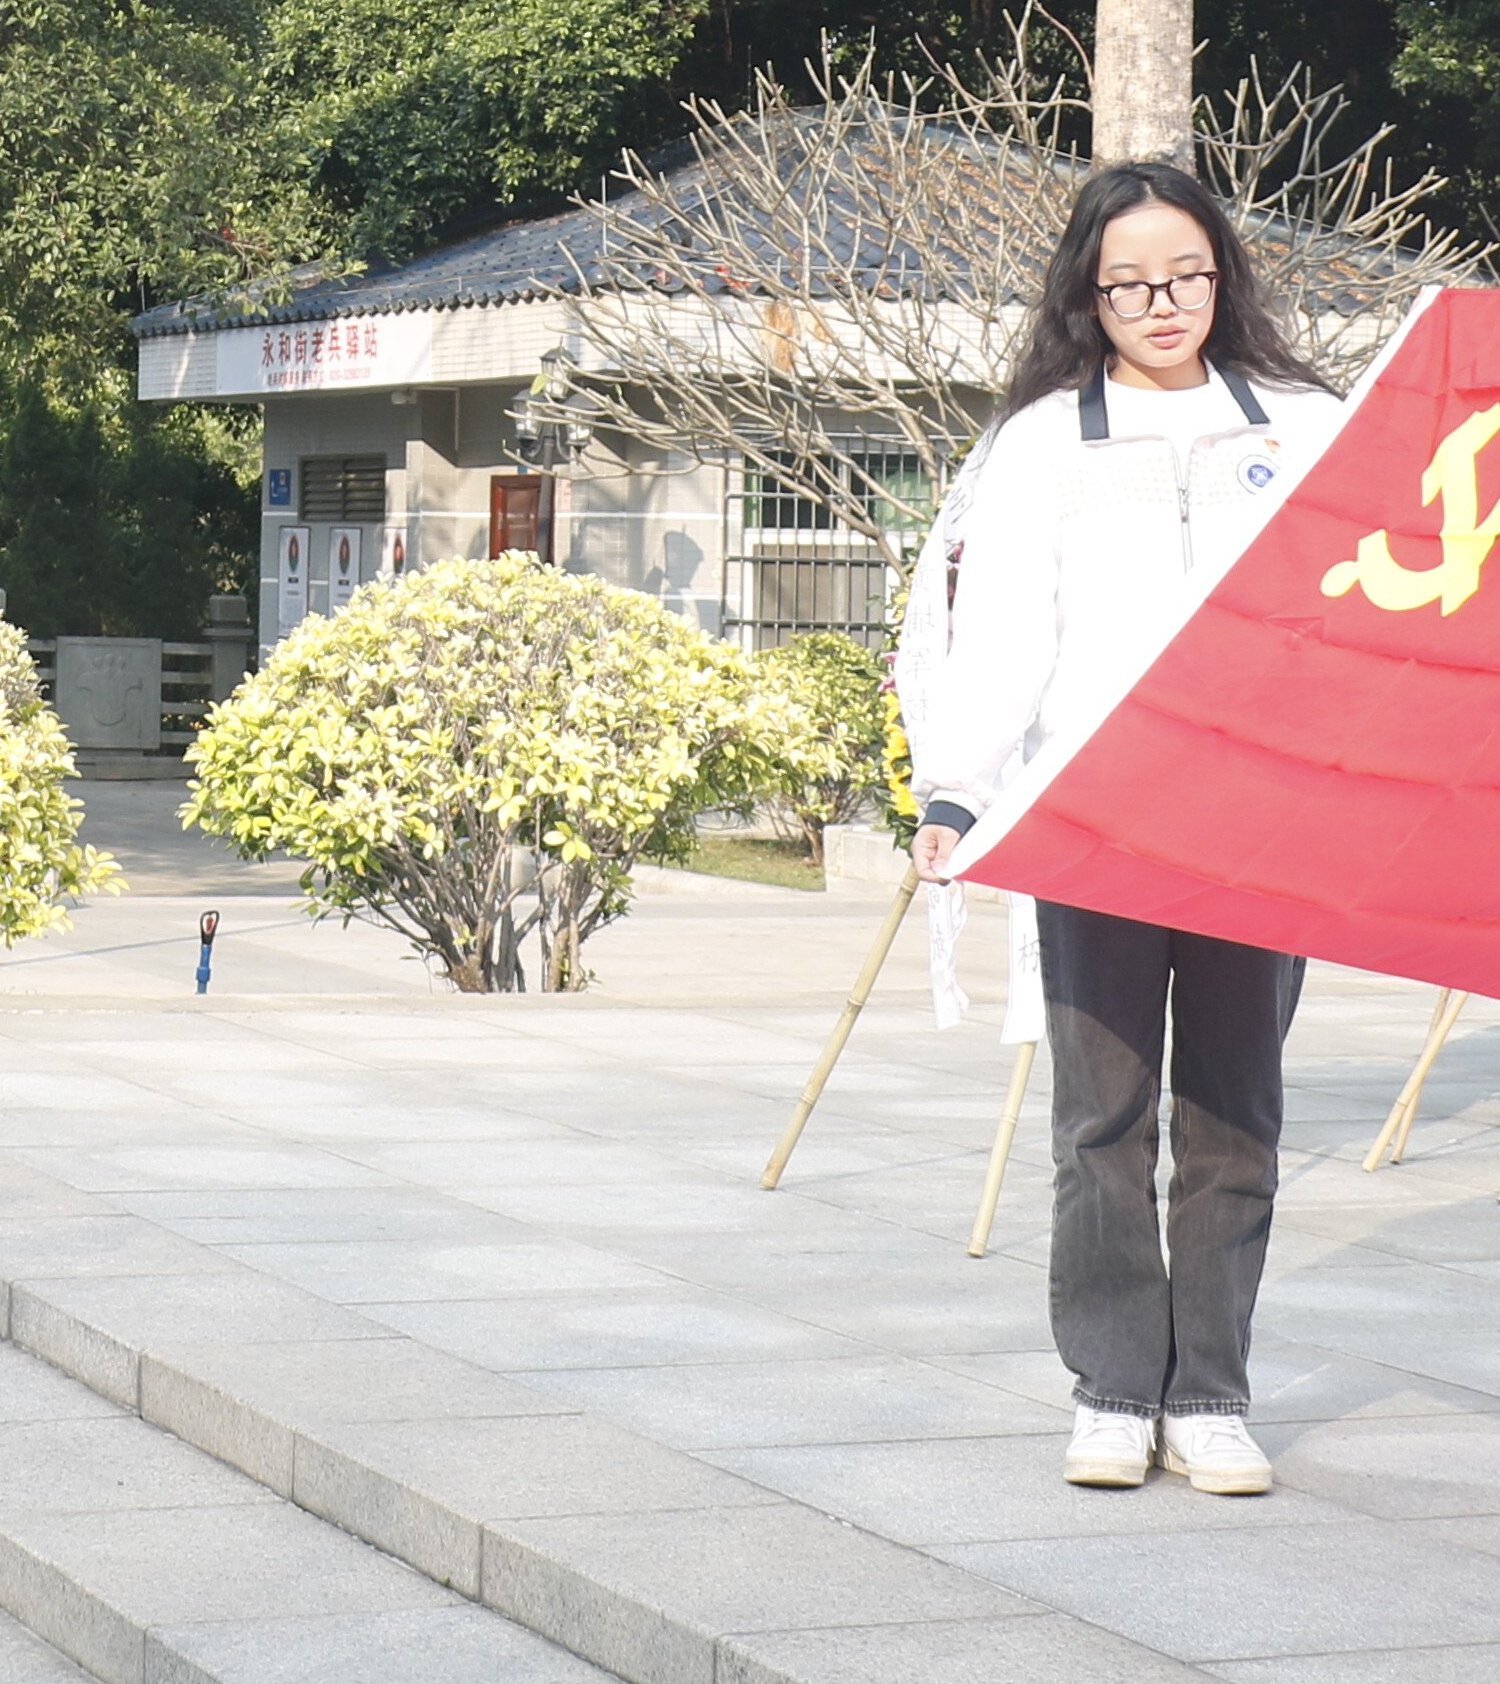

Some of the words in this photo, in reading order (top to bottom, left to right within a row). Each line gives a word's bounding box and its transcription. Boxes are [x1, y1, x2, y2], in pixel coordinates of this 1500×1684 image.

[262, 324, 378, 367] 永和街老兵驿站
